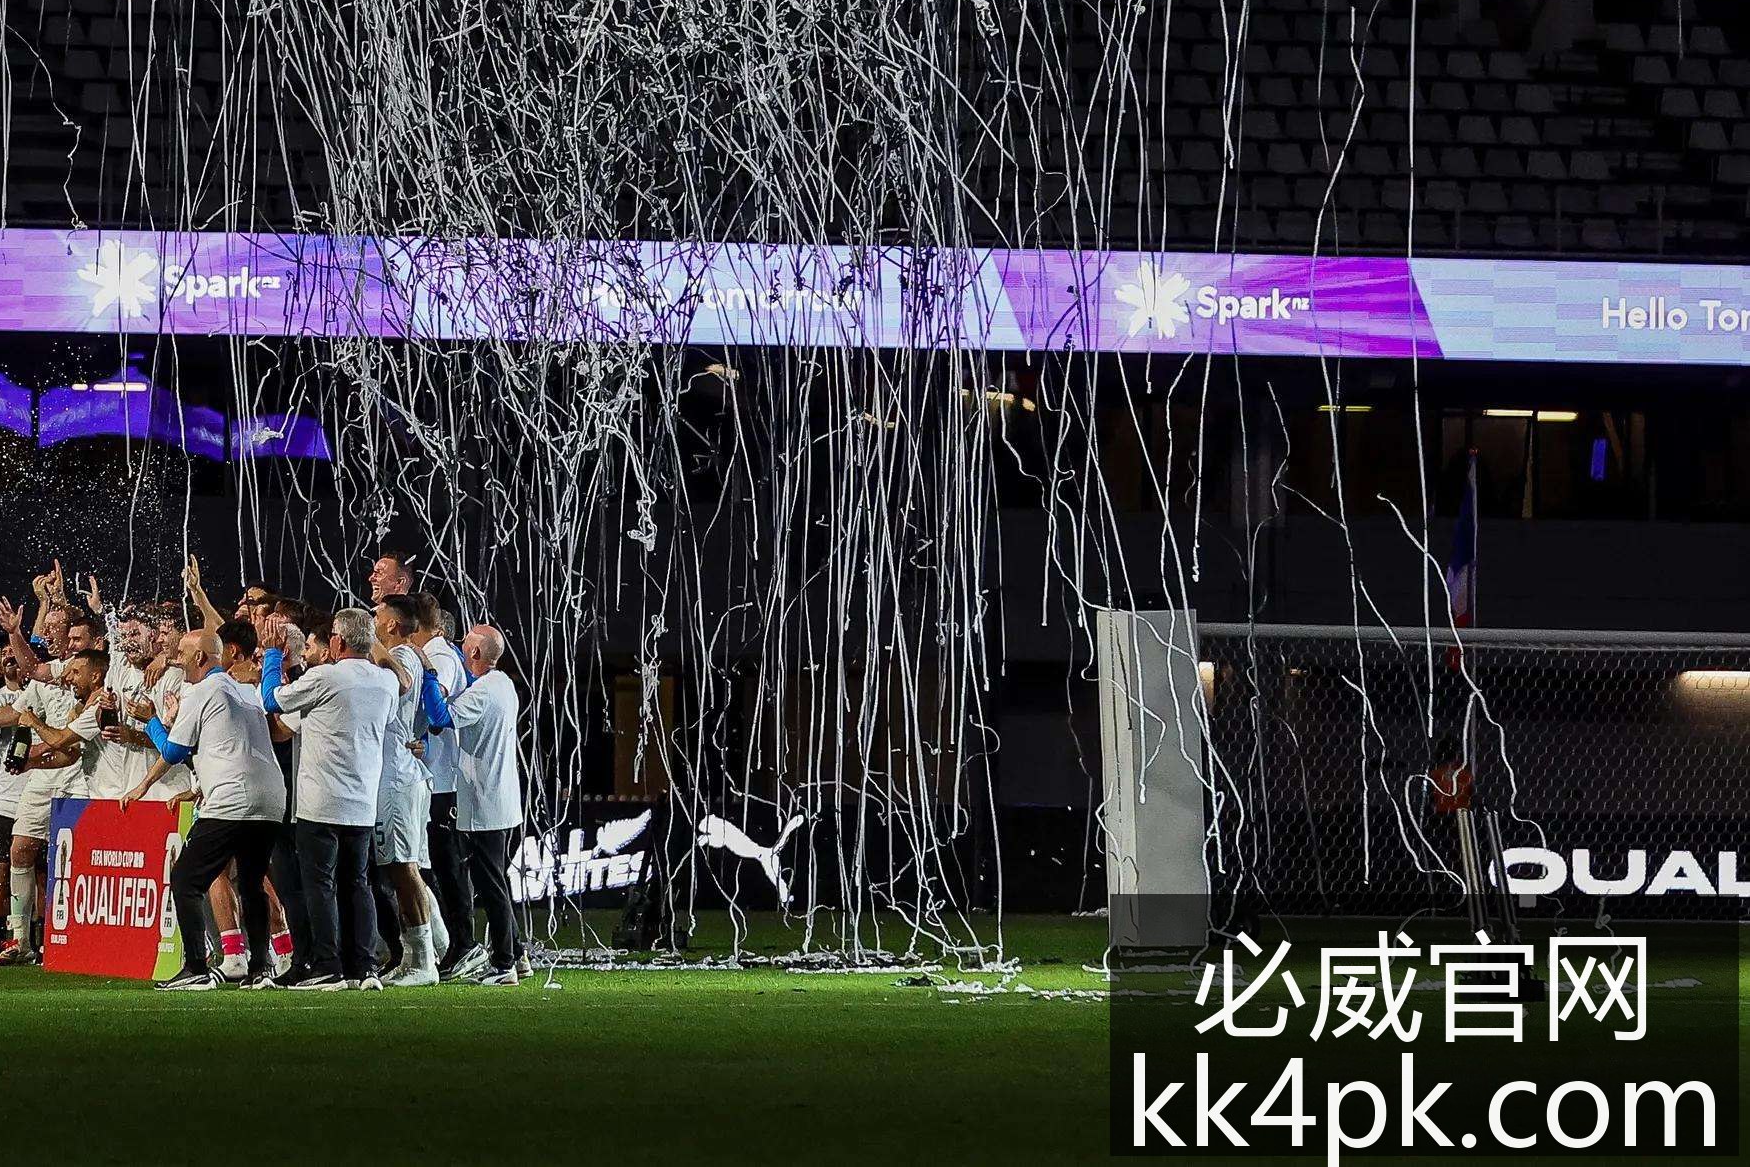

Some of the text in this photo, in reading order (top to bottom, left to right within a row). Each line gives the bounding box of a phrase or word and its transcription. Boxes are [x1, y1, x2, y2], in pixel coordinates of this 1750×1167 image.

[163, 264, 261, 305] Spark
[1196, 285, 1291, 325] Spark
[1602, 296, 1688, 331] Hello
[103, 850, 122, 867] WORLD
[73, 874, 158, 928] QUALIFIED
